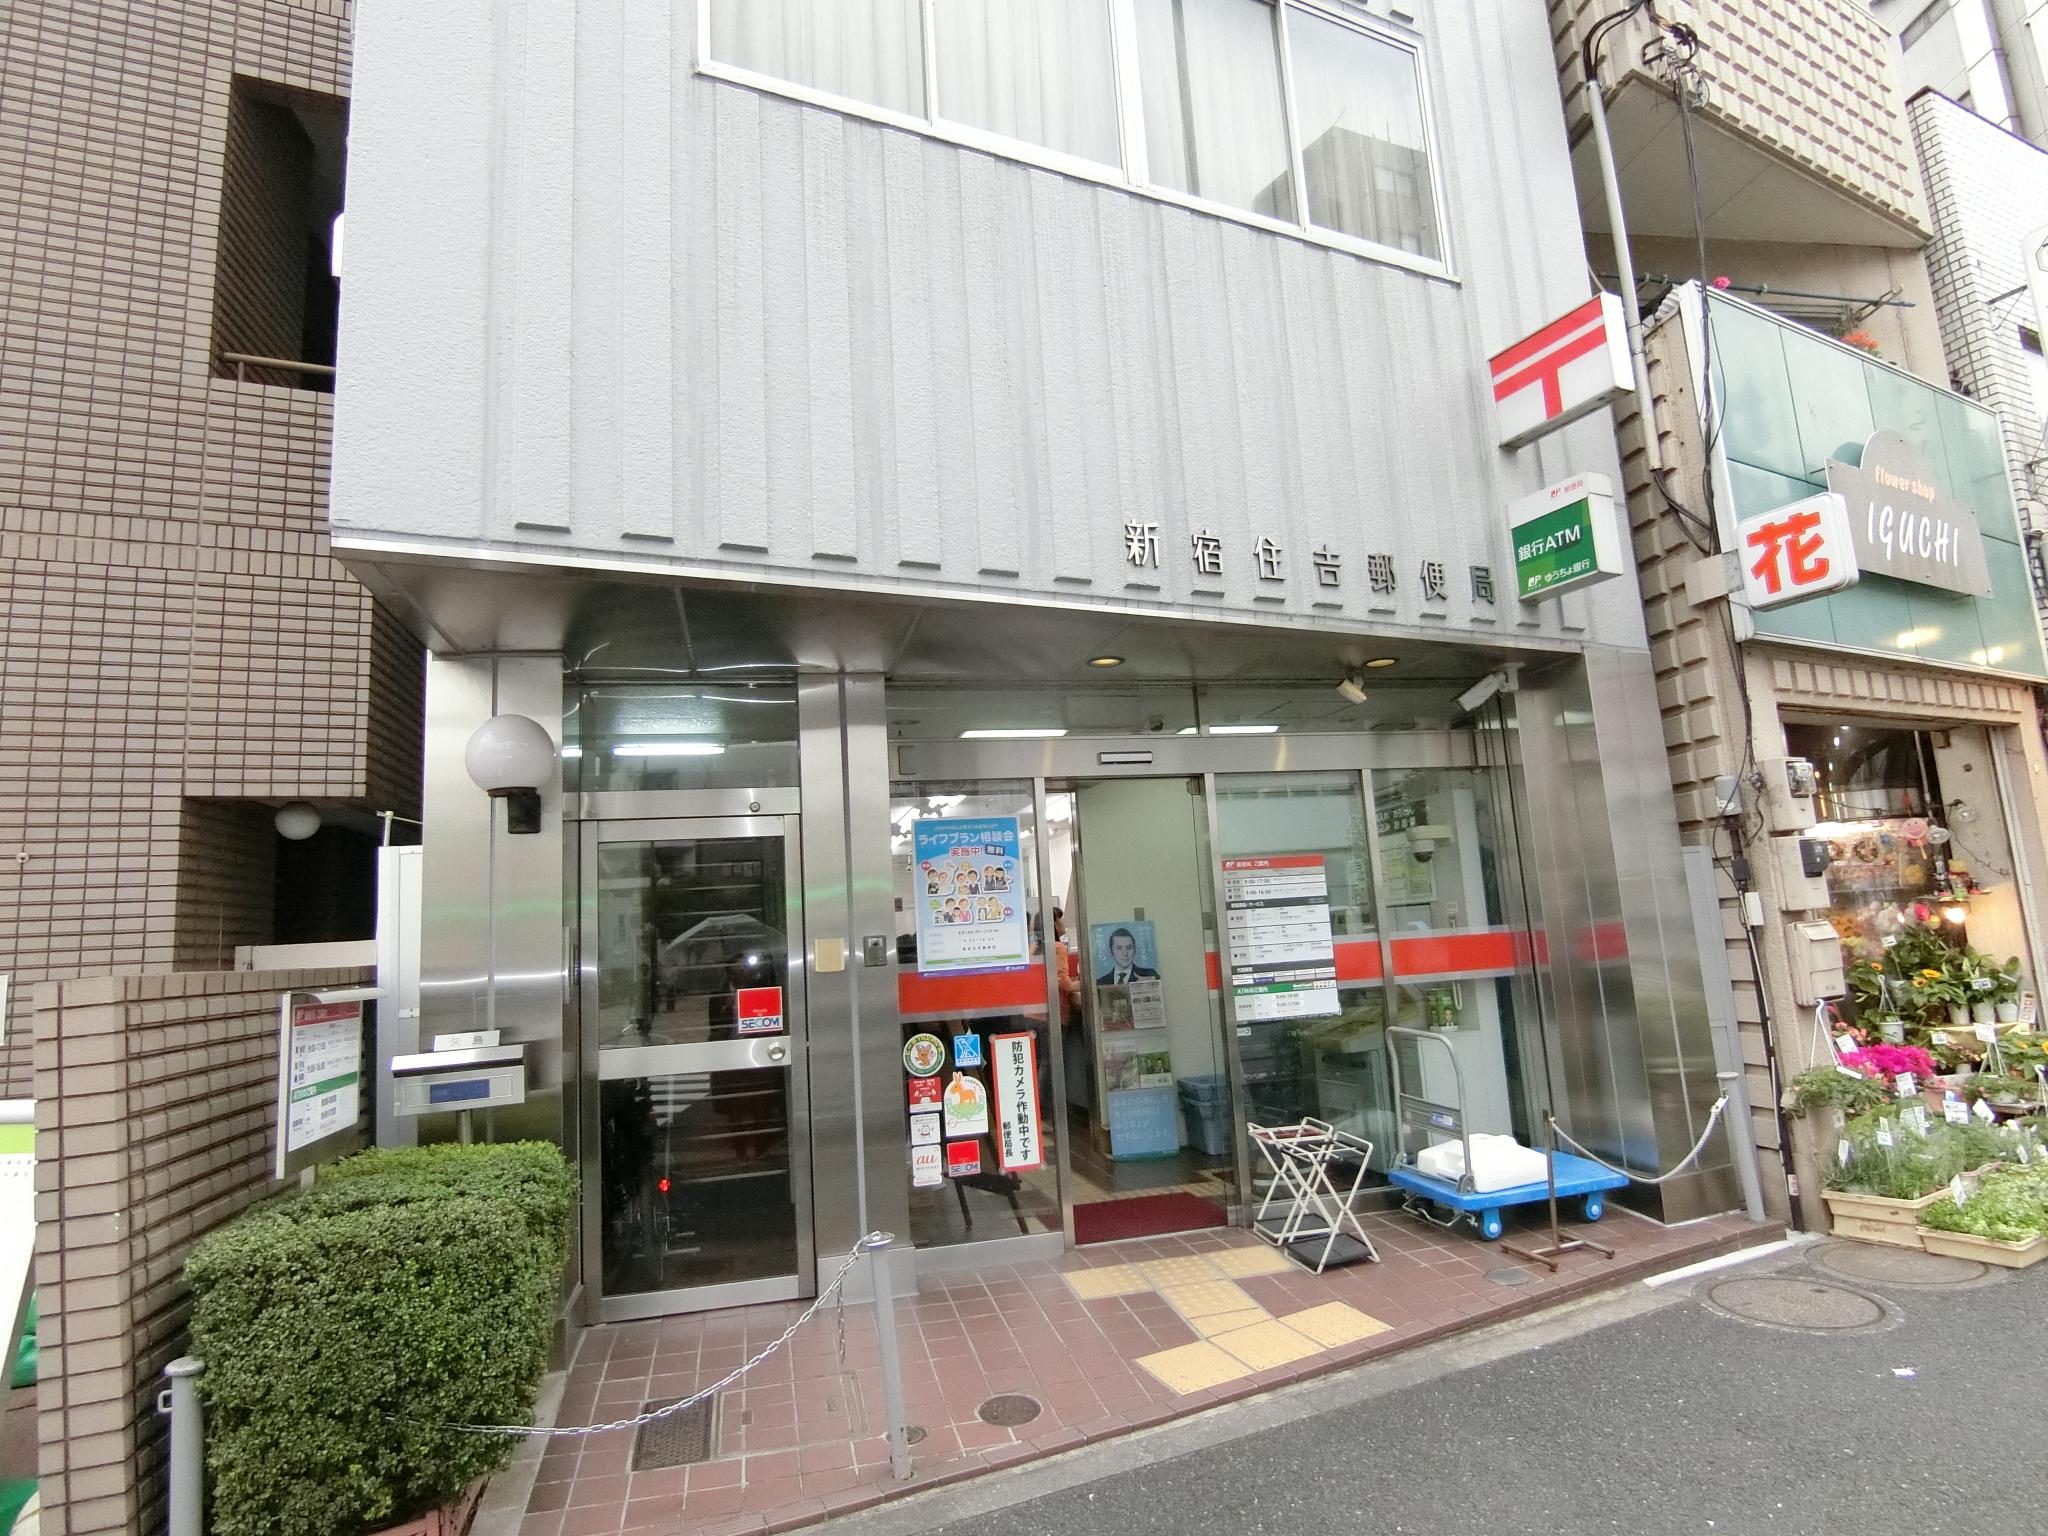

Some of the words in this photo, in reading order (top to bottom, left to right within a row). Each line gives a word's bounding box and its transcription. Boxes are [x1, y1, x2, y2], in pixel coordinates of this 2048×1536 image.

[1518, 524, 1581, 562] 銀行ATM
[1746, 511, 1830, 594] 花
[1867, 501, 1959, 567] IGUCHI
[1124, 517, 1497, 604] 新宿住吉郵便局
[1544, 559, 1590, 583] ゆうちょ銀行
[741, 1017, 780, 1029] SECOM
[1011, 1041, 1031, 1161] 防犯カメラ作動中です
[916, 1153, 937, 1166] au
